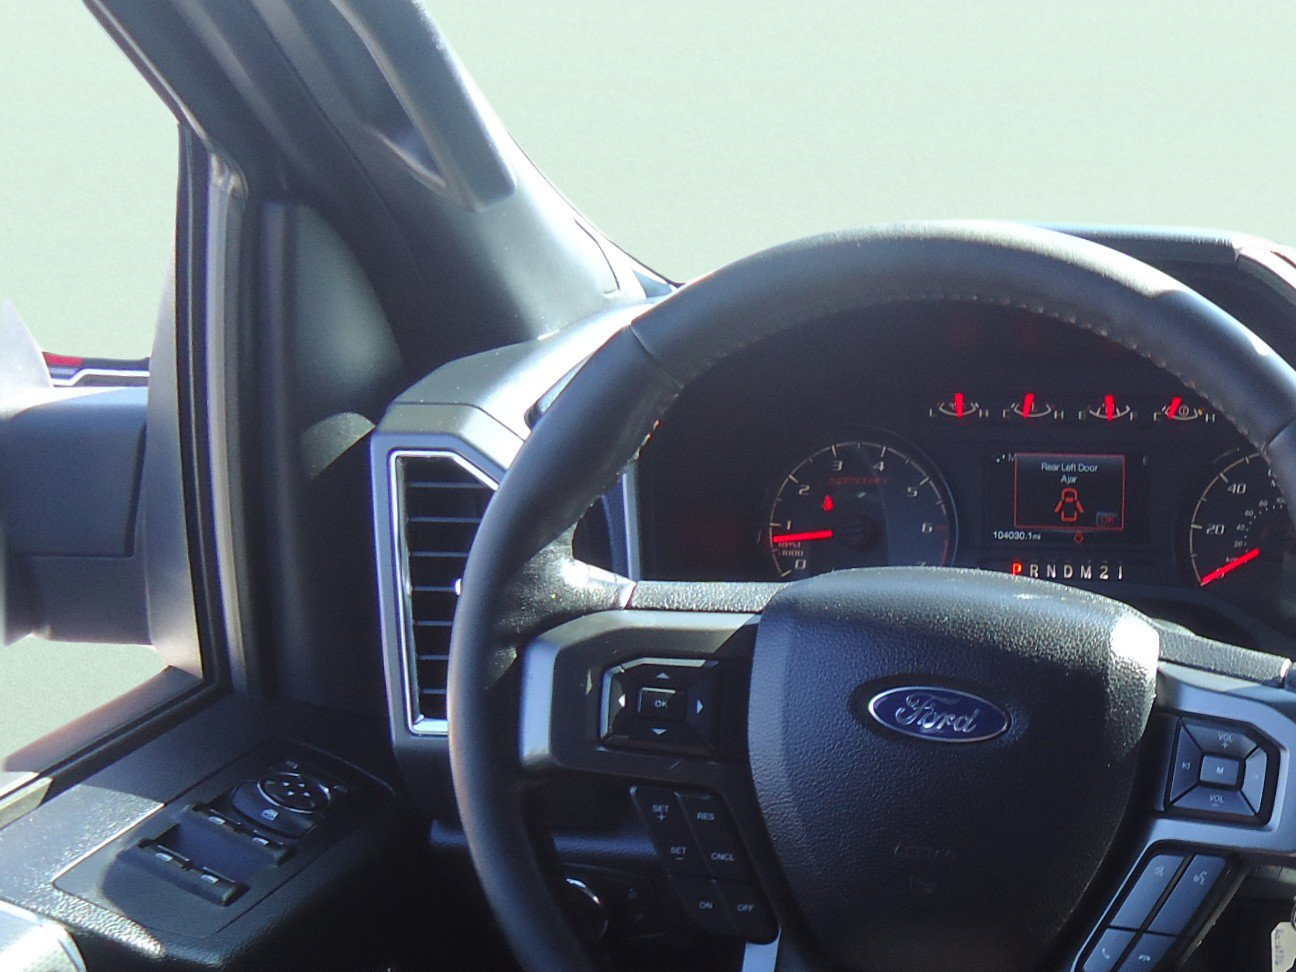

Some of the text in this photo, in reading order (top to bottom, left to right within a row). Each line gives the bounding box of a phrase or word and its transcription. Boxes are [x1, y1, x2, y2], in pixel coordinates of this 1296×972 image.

[831, 459, 843, 471] 3
[873, 460, 886, 472] 4
[1041, 462, 1098, 472] Rear Left Door
[1060, 475, 1078, 485] Ajar
[799, 484, 811, 496] 2
[907, 485, 919, 498] 5
[1226, 482, 1247, 495] 40
[786, 519, 792, 530] 1
[921, 521, 933, 534] 6
[1206, 523, 1225, 535] 20
[794, 558, 807, 571] 0
[1011, 560, 1024, 576] P
[1029, 562, 1039, 579] R
[1046, 563, 1057, 579] N
[1063, 563, 1074, 579] D
[1080, 563, 1093, 580] M
[1099, 564, 1110, 580] 2
[895, 691, 982, 733] Ford
